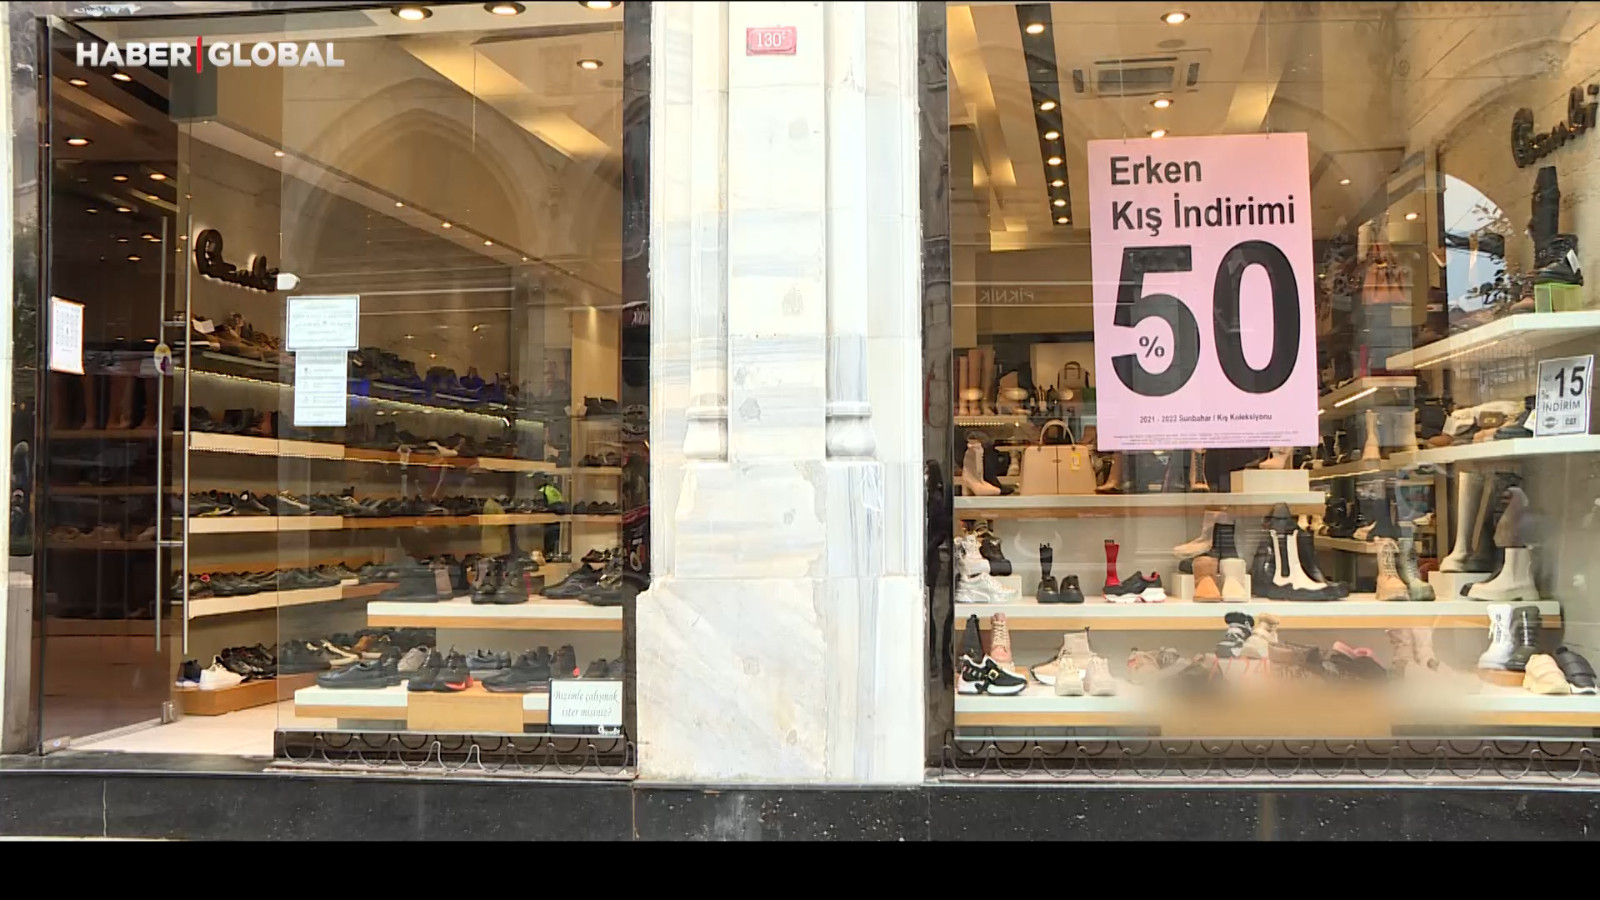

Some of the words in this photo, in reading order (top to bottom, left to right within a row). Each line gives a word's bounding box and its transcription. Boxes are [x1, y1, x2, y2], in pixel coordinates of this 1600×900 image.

[1110, 155, 1202, 185] Erken
[1111, 200, 1162, 236] Kış
[1174, 192, 1295, 228] İndirimi
[1111, 239, 1301, 397] 50
[1138, 335, 1165, 358] %
[1554, 366, 1586, 398] 15
[1543, 399, 1581, 413] İNDİRİM
